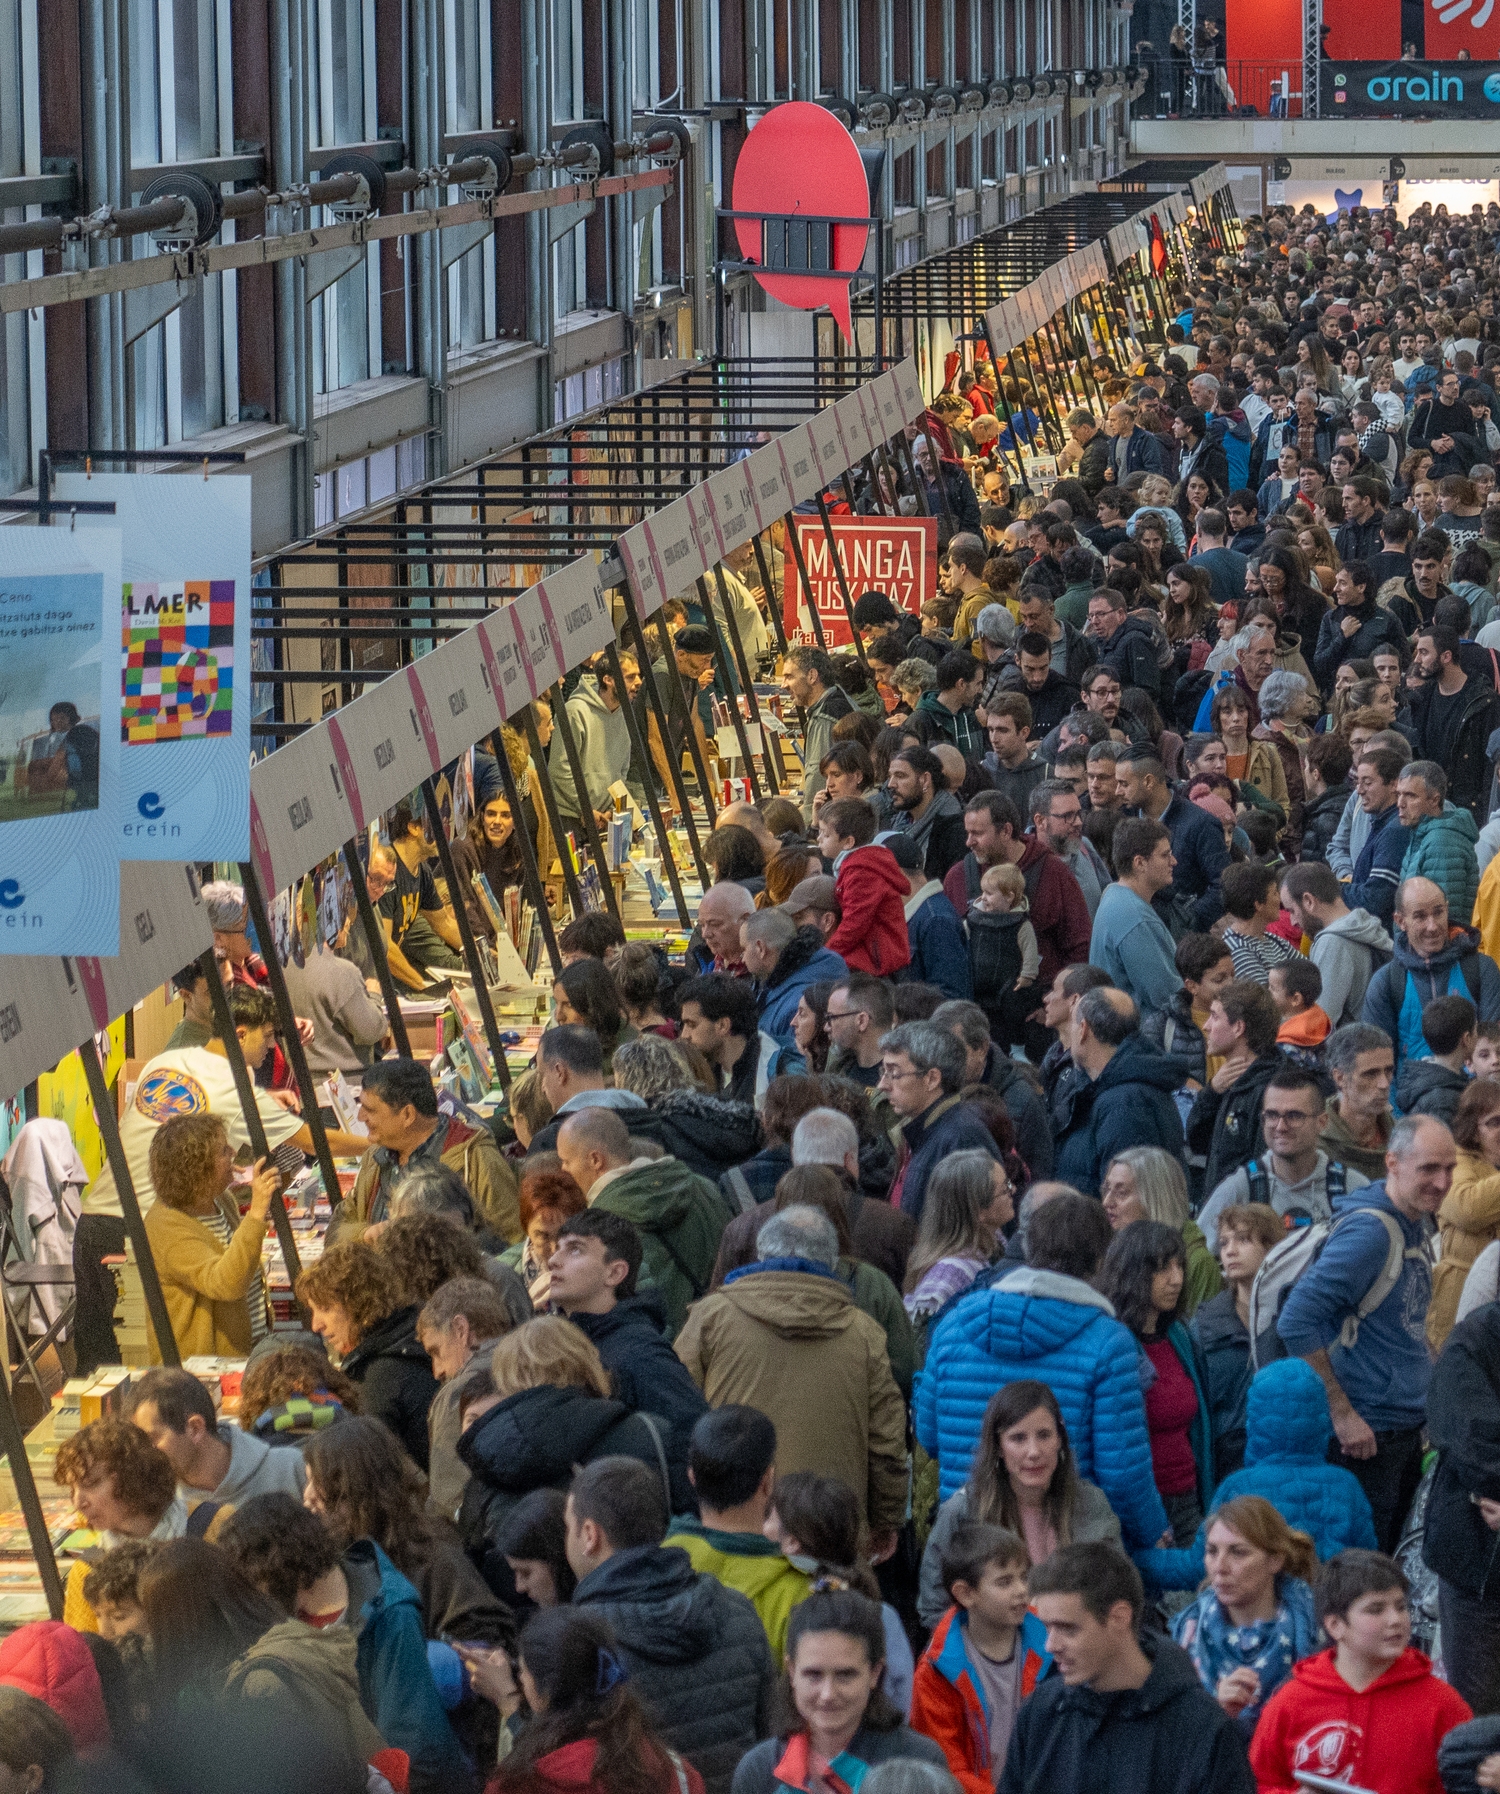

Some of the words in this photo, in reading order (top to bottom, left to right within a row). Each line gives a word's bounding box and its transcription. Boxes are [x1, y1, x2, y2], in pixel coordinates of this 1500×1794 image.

[1367, 71, 1464, 102] orain
[808, 538, 914, 579] MANGA
[122, 592, 204, 615] LMER
[122, 822, 181, 837] erein
